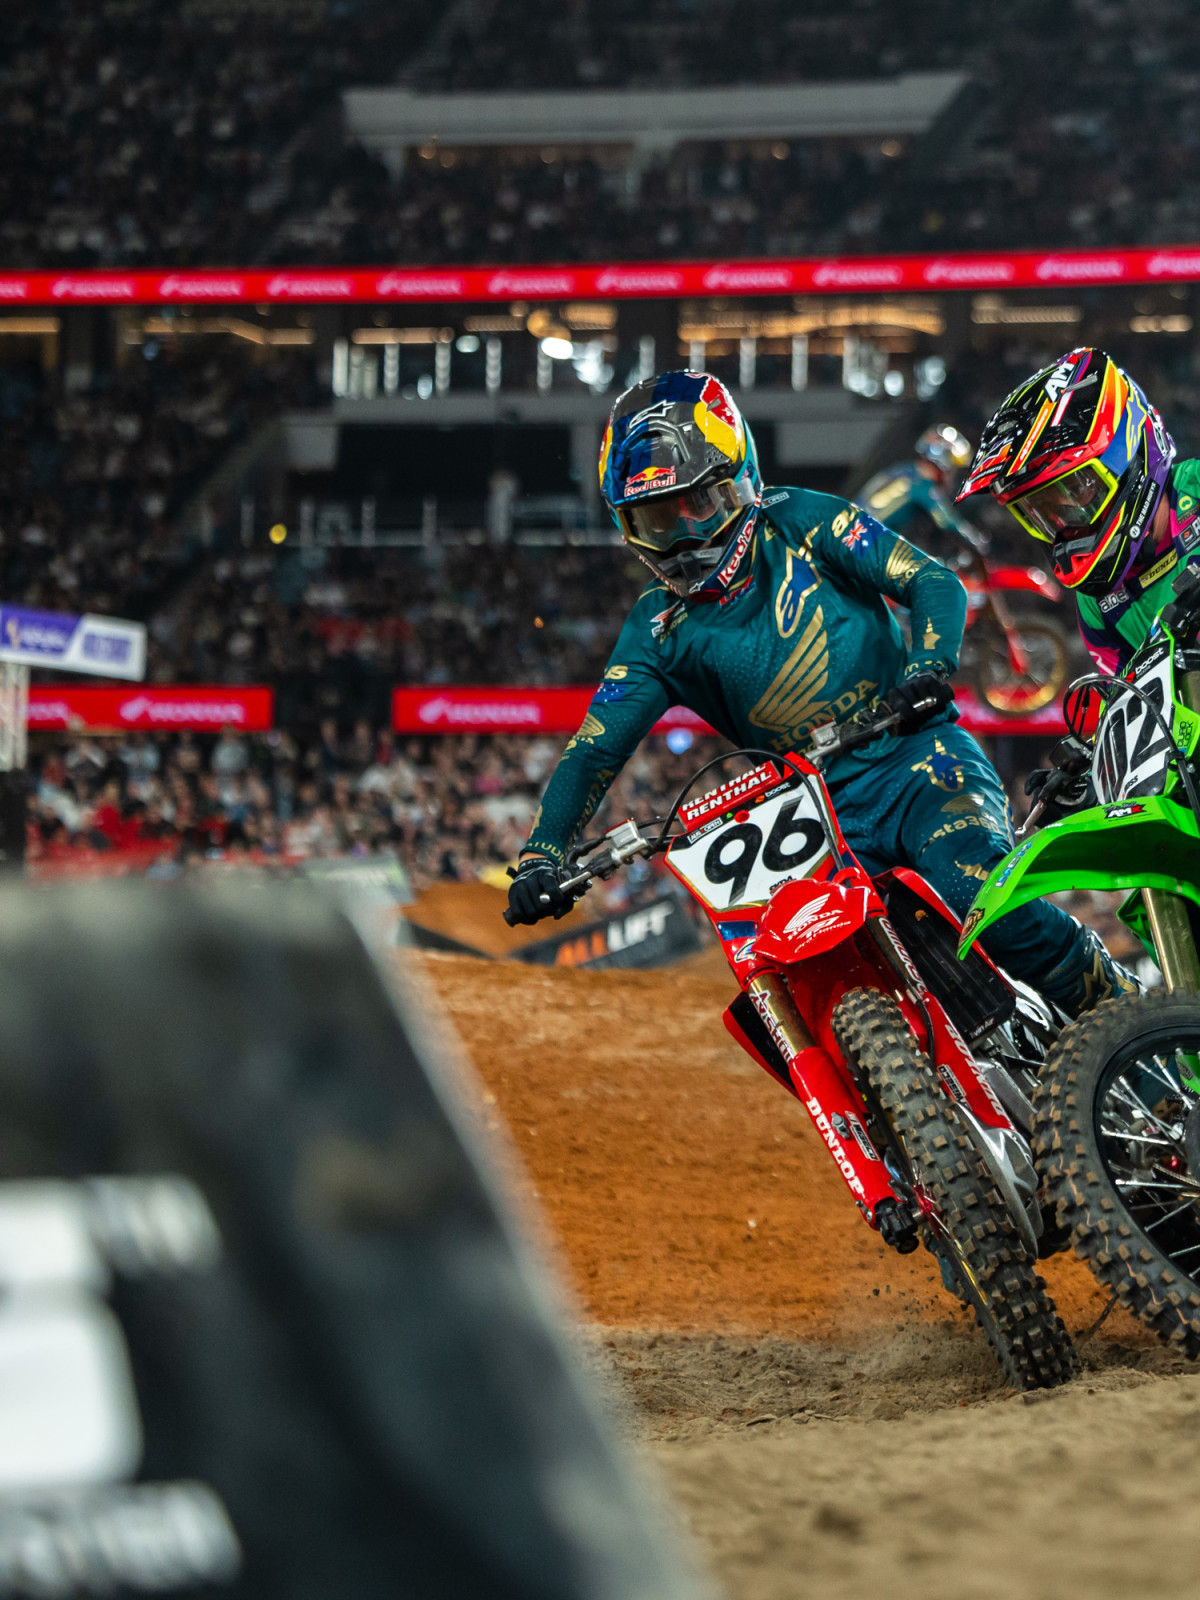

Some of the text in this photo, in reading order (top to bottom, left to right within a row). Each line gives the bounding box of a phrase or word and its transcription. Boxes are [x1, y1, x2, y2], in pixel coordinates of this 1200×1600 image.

[624, 475, 676, 498] Red Bull
[1149, 553, 1178, 578] DUNLO
[1135, 647, 1164, 674] boost
[686, 771, 772, 821] RENTHAL
[764, 782, 791, 798] boost
[1107, 804, 1143, 818] AMX
[704, 795, 826, 906] 96
[787, 909, 844, 941] HONDA
[806, 1097, 865, 1198] DUNLOP
